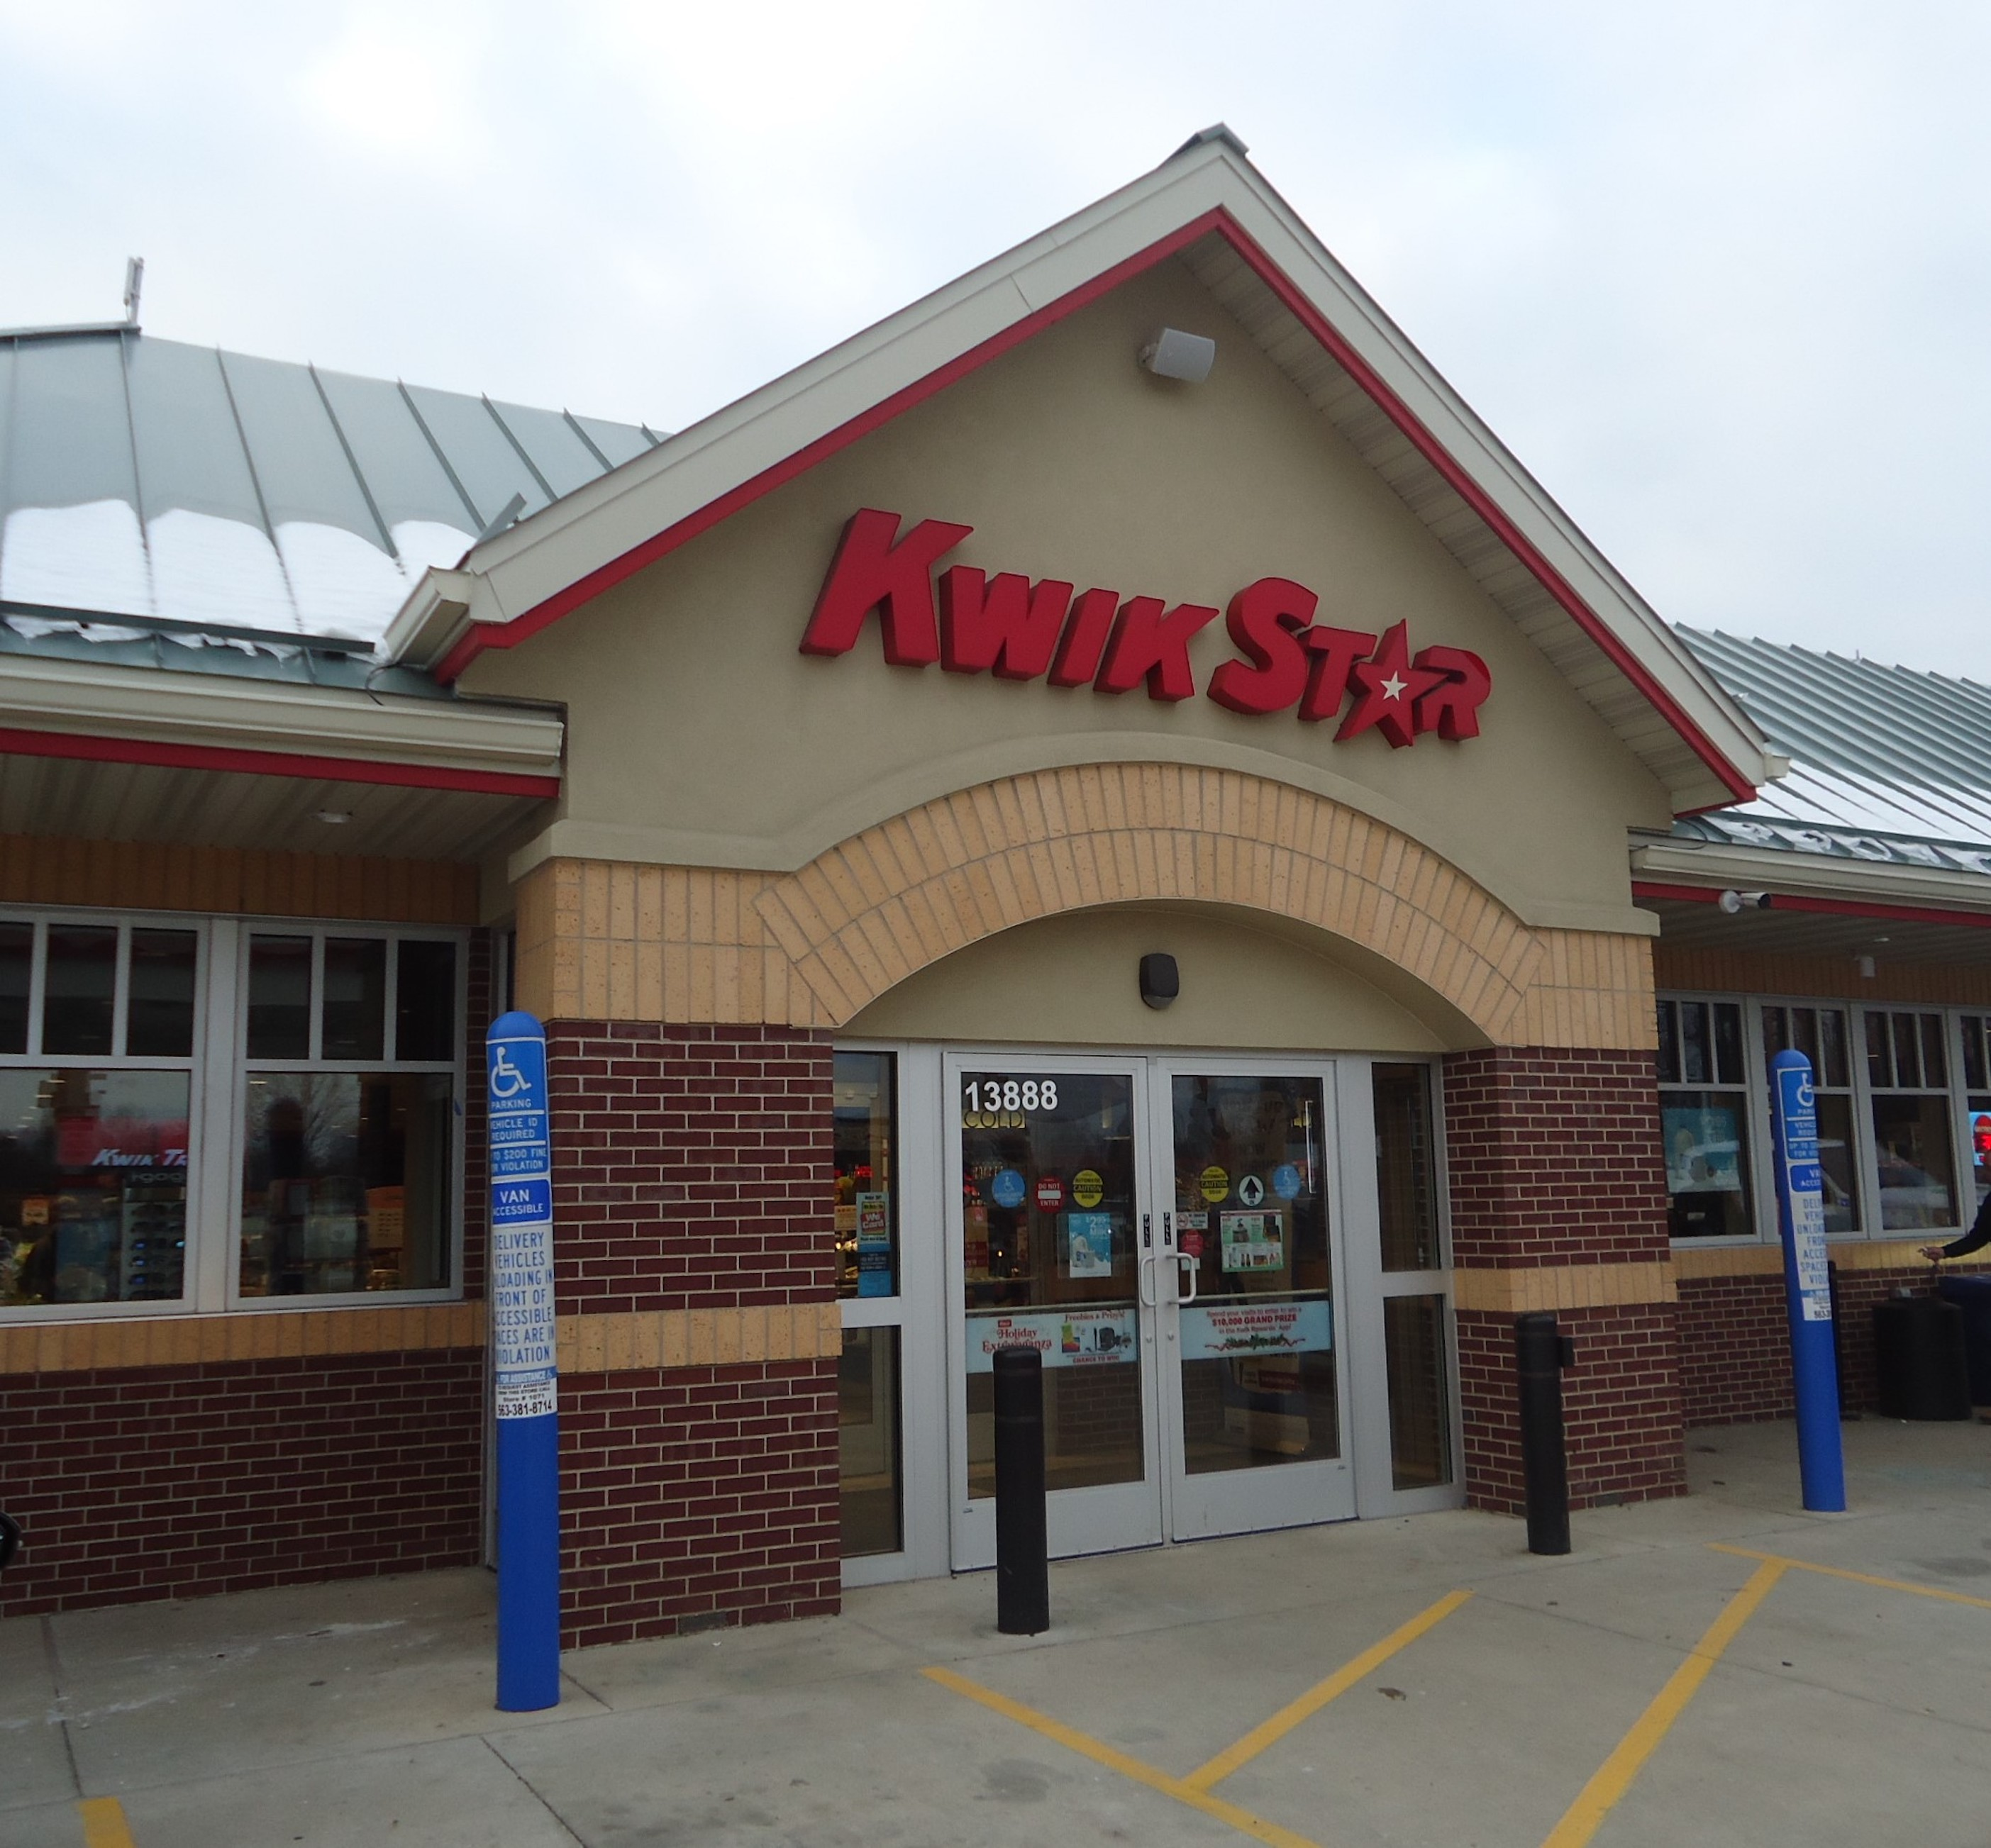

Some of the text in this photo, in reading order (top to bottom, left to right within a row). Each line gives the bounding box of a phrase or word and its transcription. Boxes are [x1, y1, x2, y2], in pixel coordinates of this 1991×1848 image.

[799, 508, 1219, 702] KWIK
[965, 1080, 1058, 1112] 13888
[491, 1098, 532, 1110] PARKING
[492, 1118, 538, 1129] EHICLE ID
[504, 1149, 527, 1160] $200
[531, 1147, 547, 1157] FINE
[501, 1160, 543, 1171] VIOLATION
[500, 1189, 529, 1203] VAN
[494, 1270, 541, 1288] LOADING
[533, 1289, 546, 1304] OF
[496, 1307, 552, 1326] CCESSIBLE
[1212, 1313, 1297, 1327] $10,000 GRAND PRIZE
[495, 1329, 518, 1345] ACES
[524, 1327, 544, 1344] ARE
[997, 1328, 1038, 1340] Holiday
[498, 1399, 552, 1417] 563-381-8714
